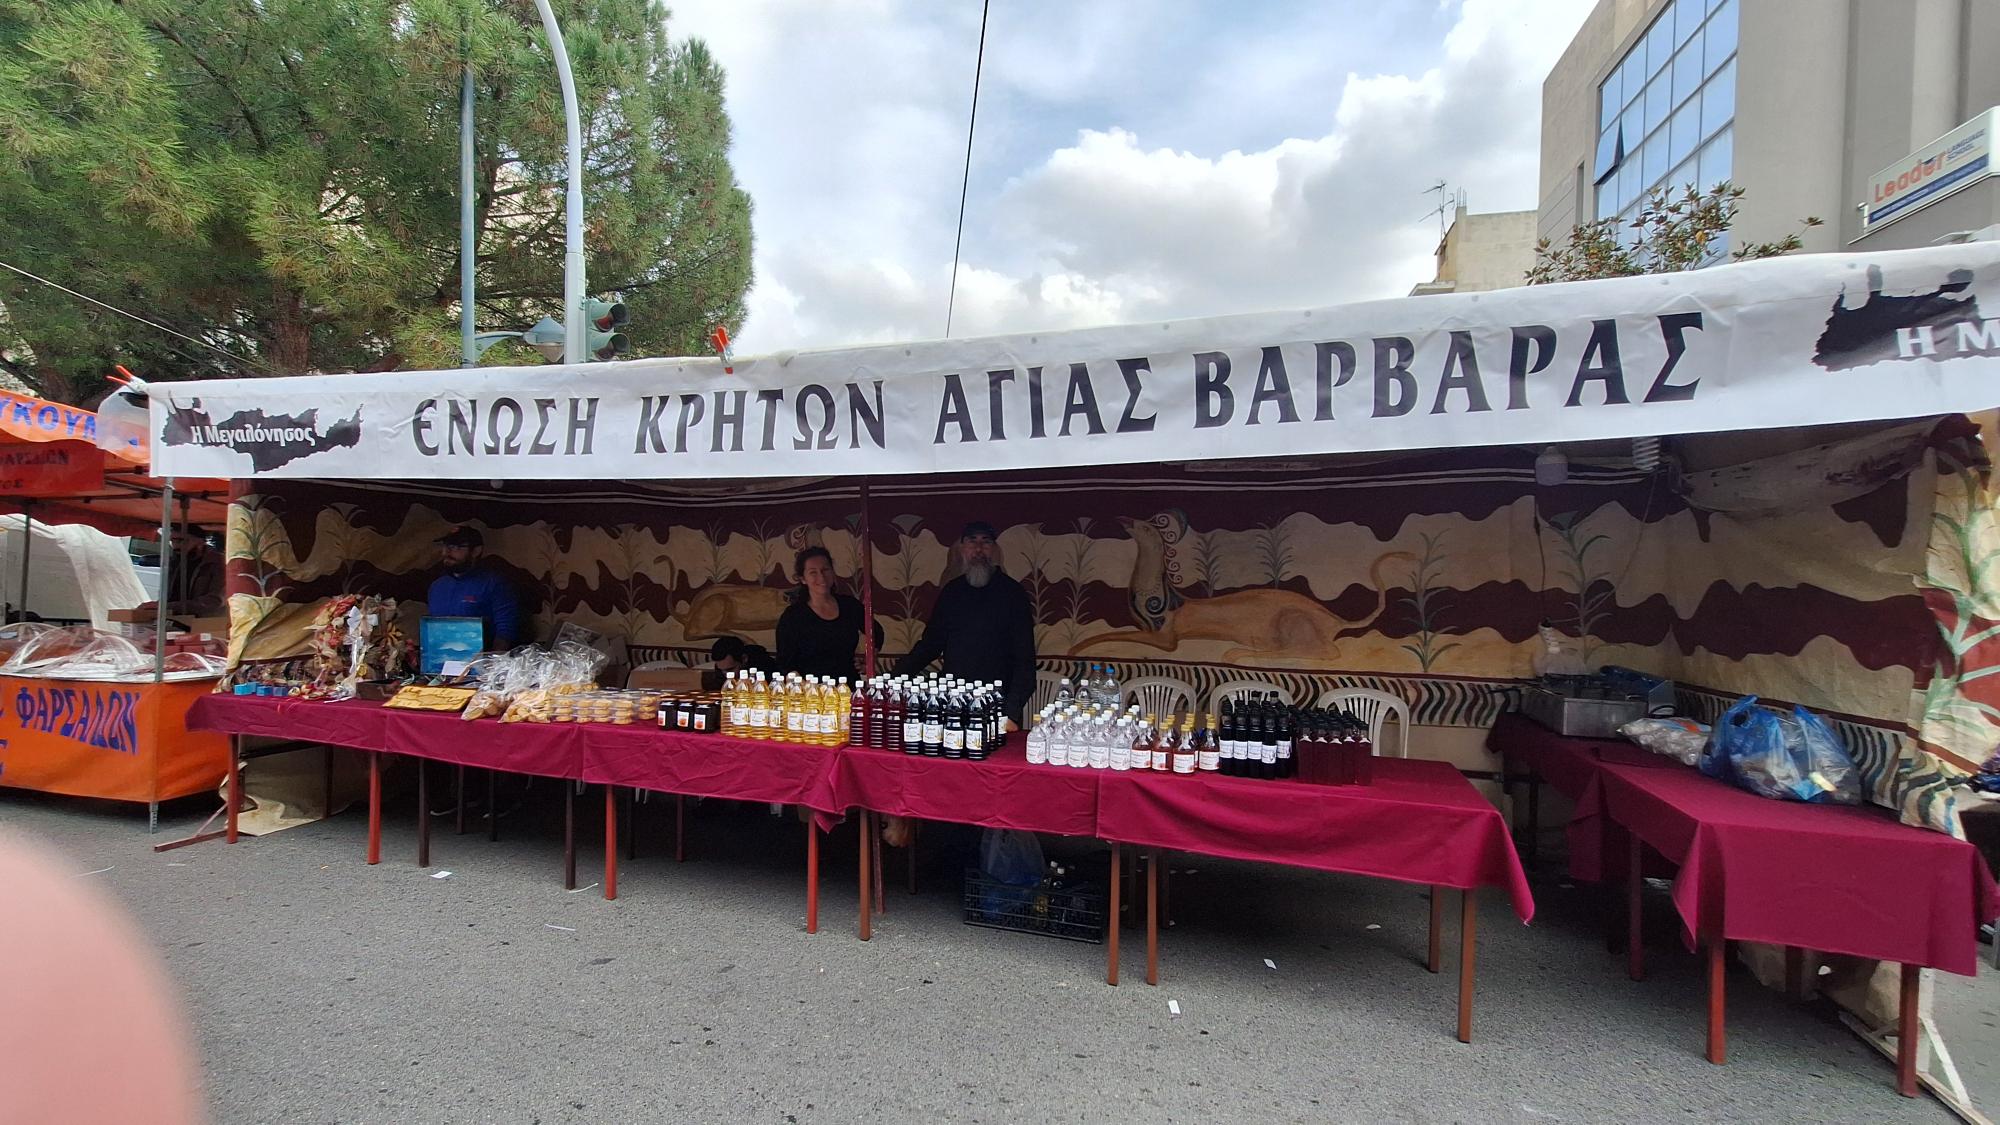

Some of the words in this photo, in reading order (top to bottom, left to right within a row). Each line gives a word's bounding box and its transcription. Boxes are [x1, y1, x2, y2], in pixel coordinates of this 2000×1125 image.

[1875, 151, 1946, 203] Leader
[1896, 325, 1938, 357] Η
[412, 396, 600, 456] ΕΝΩΣΗ
[634, 379, 887, 455] ΚΡΗΤΩΝ
[933, 356, 1159, 445] ΑΓΙΑΣ
[1192, 311, 1704, 429] ΒΑΡΒΑΡΑΣ
[192, 426, 204, 444] Η
[205, 424, 316, 447] Μεγαλόνησος
